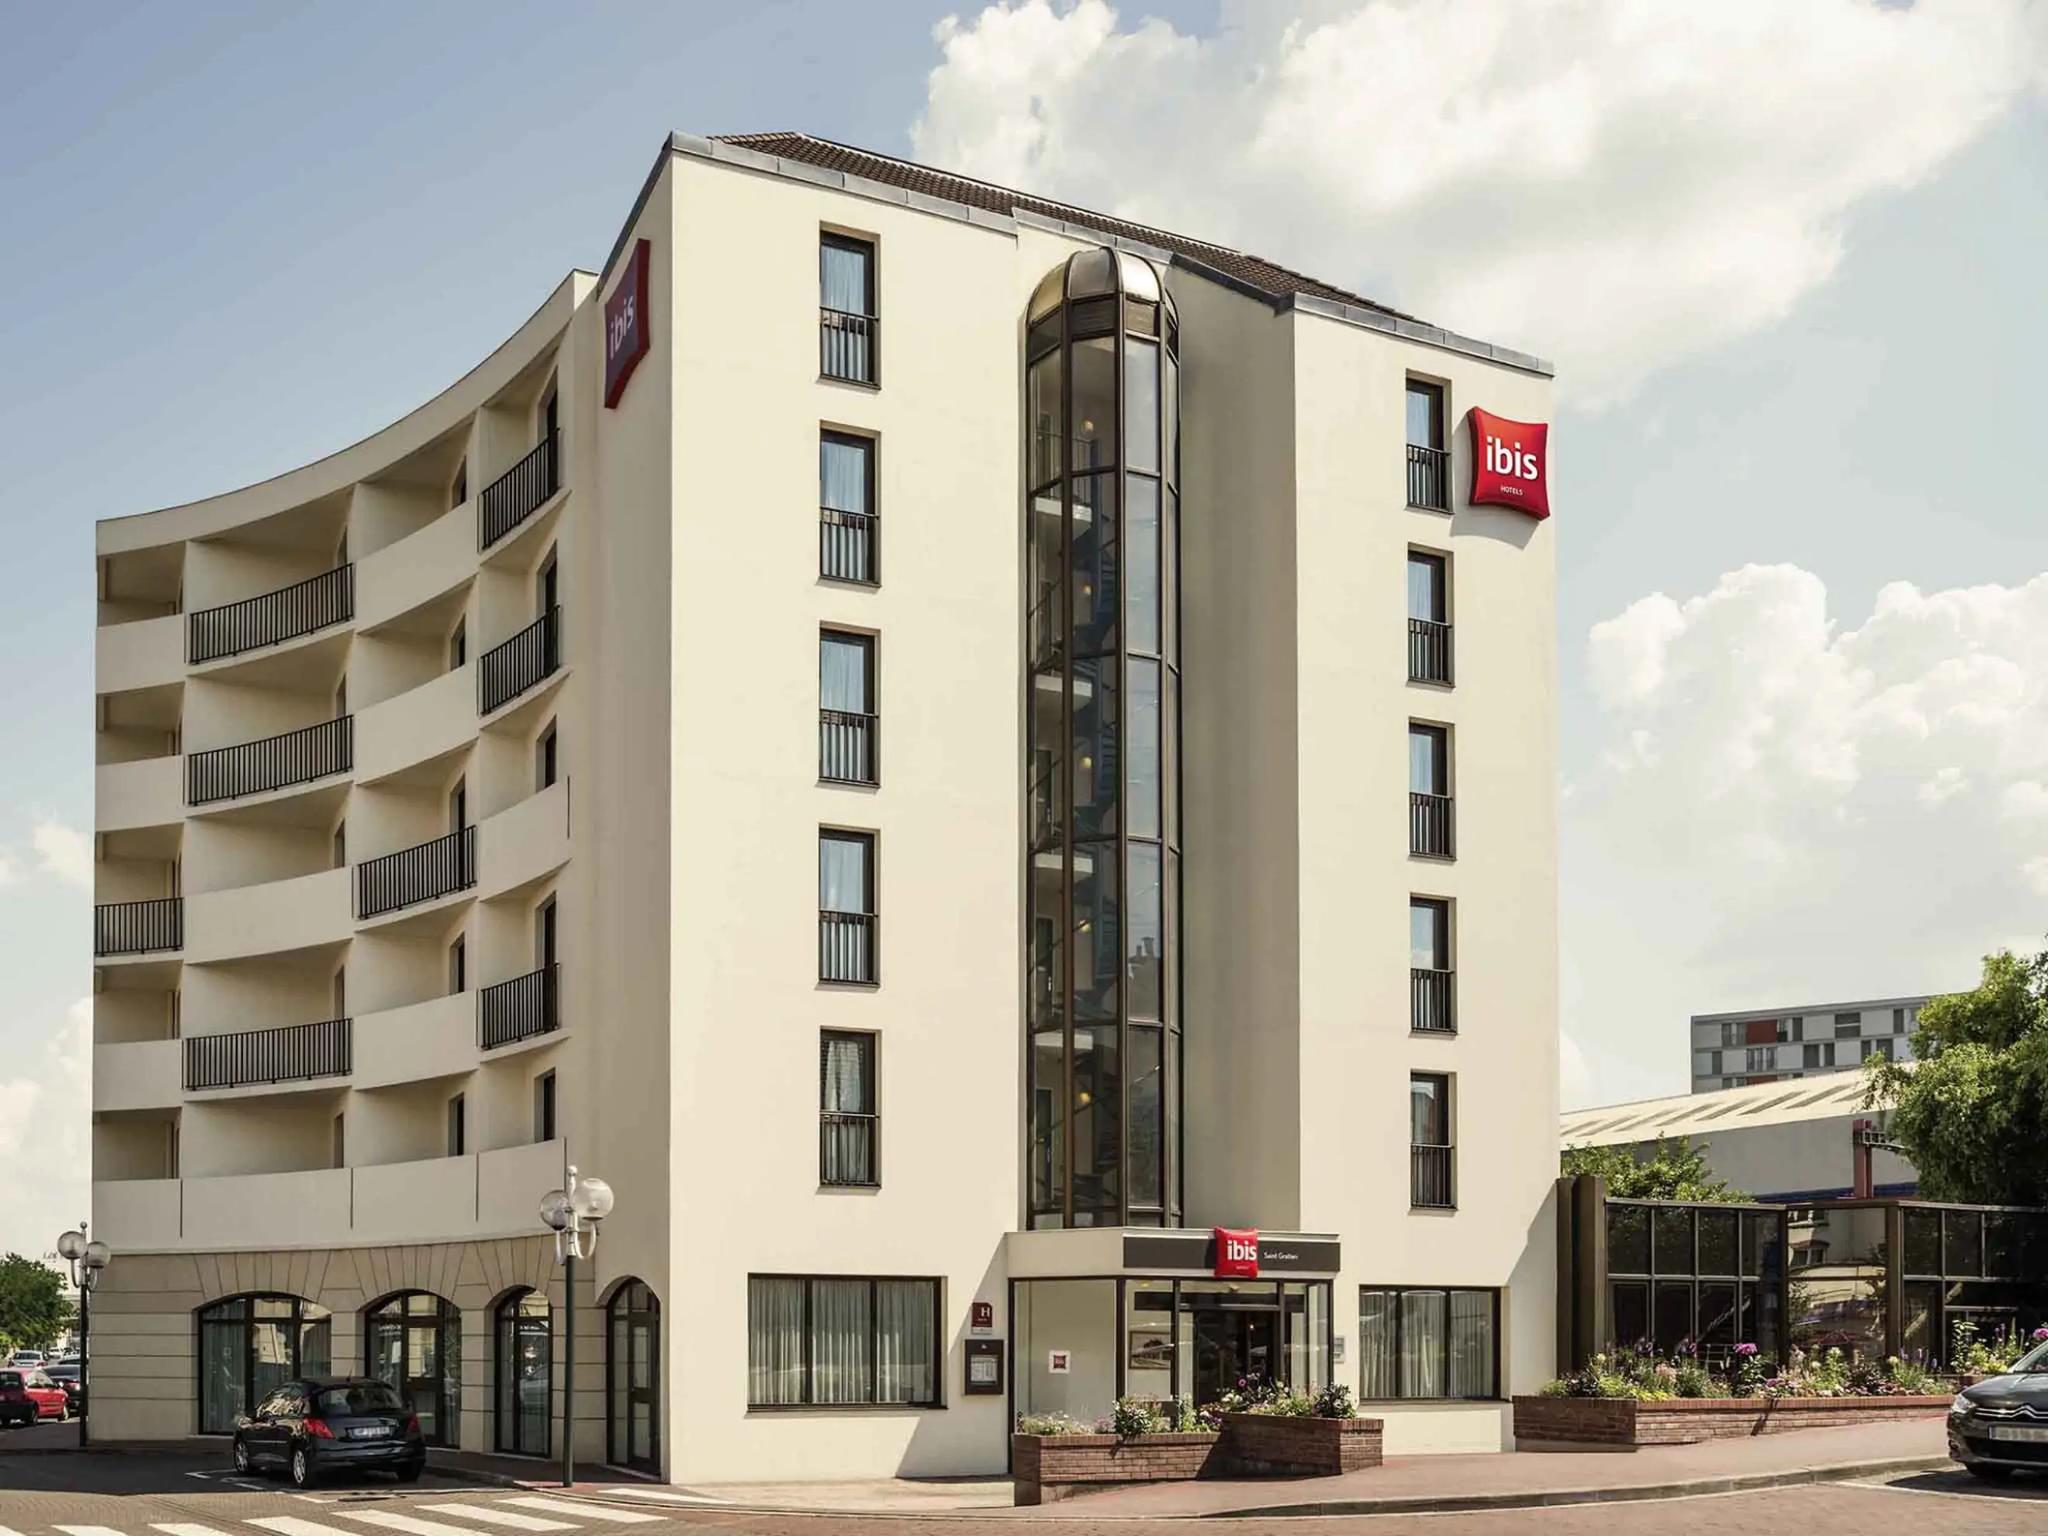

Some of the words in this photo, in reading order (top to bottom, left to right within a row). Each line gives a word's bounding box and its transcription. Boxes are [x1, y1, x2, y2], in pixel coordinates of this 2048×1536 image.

[610, 296, 634, 360] ibis
[1487, 436, 1538, 480] ibis
[1500, 485, 1524, 496] HOTELS
[1227, 1240, 1257, 1261] ibis
